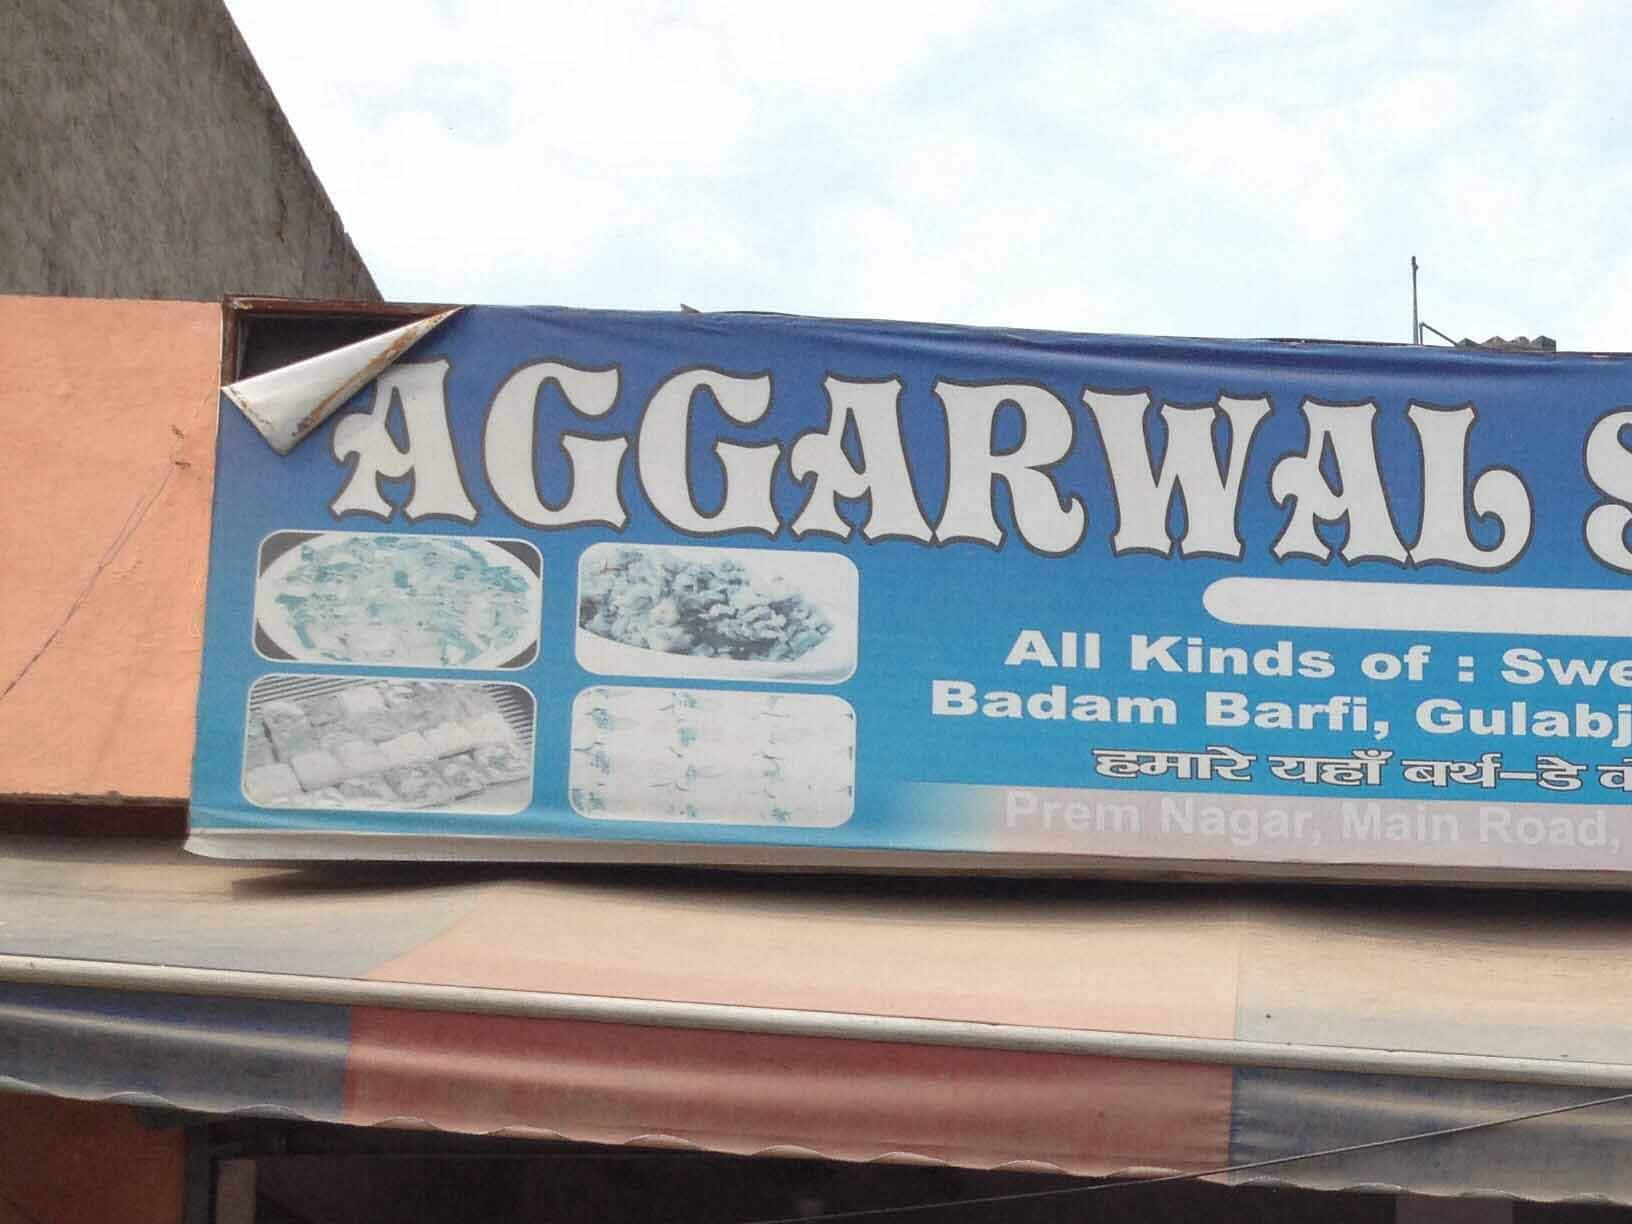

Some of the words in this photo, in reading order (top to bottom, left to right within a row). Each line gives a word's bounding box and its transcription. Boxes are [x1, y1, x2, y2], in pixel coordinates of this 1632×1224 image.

[331, 358, 1533, 571] AGGARWAL
[1004, 629, 1099, 669] All
[1130, 634, 1336, 679] Kinds
[1361, 645, 1432, 681] of
[932, 679, 1177, 724] Badam
[1206, 691, 1389, 740] Barfi,
[1093, 745, 1257, 781] हमारे
[1269, 747, 1393, 787] यहाँ
[1001, 790, 1141, 833] Prem
[1160, 796, 1322, 847] Nagar,
[1342, 801, 1459, 843] Main
[1480, 808, 1620, 852] Road,
